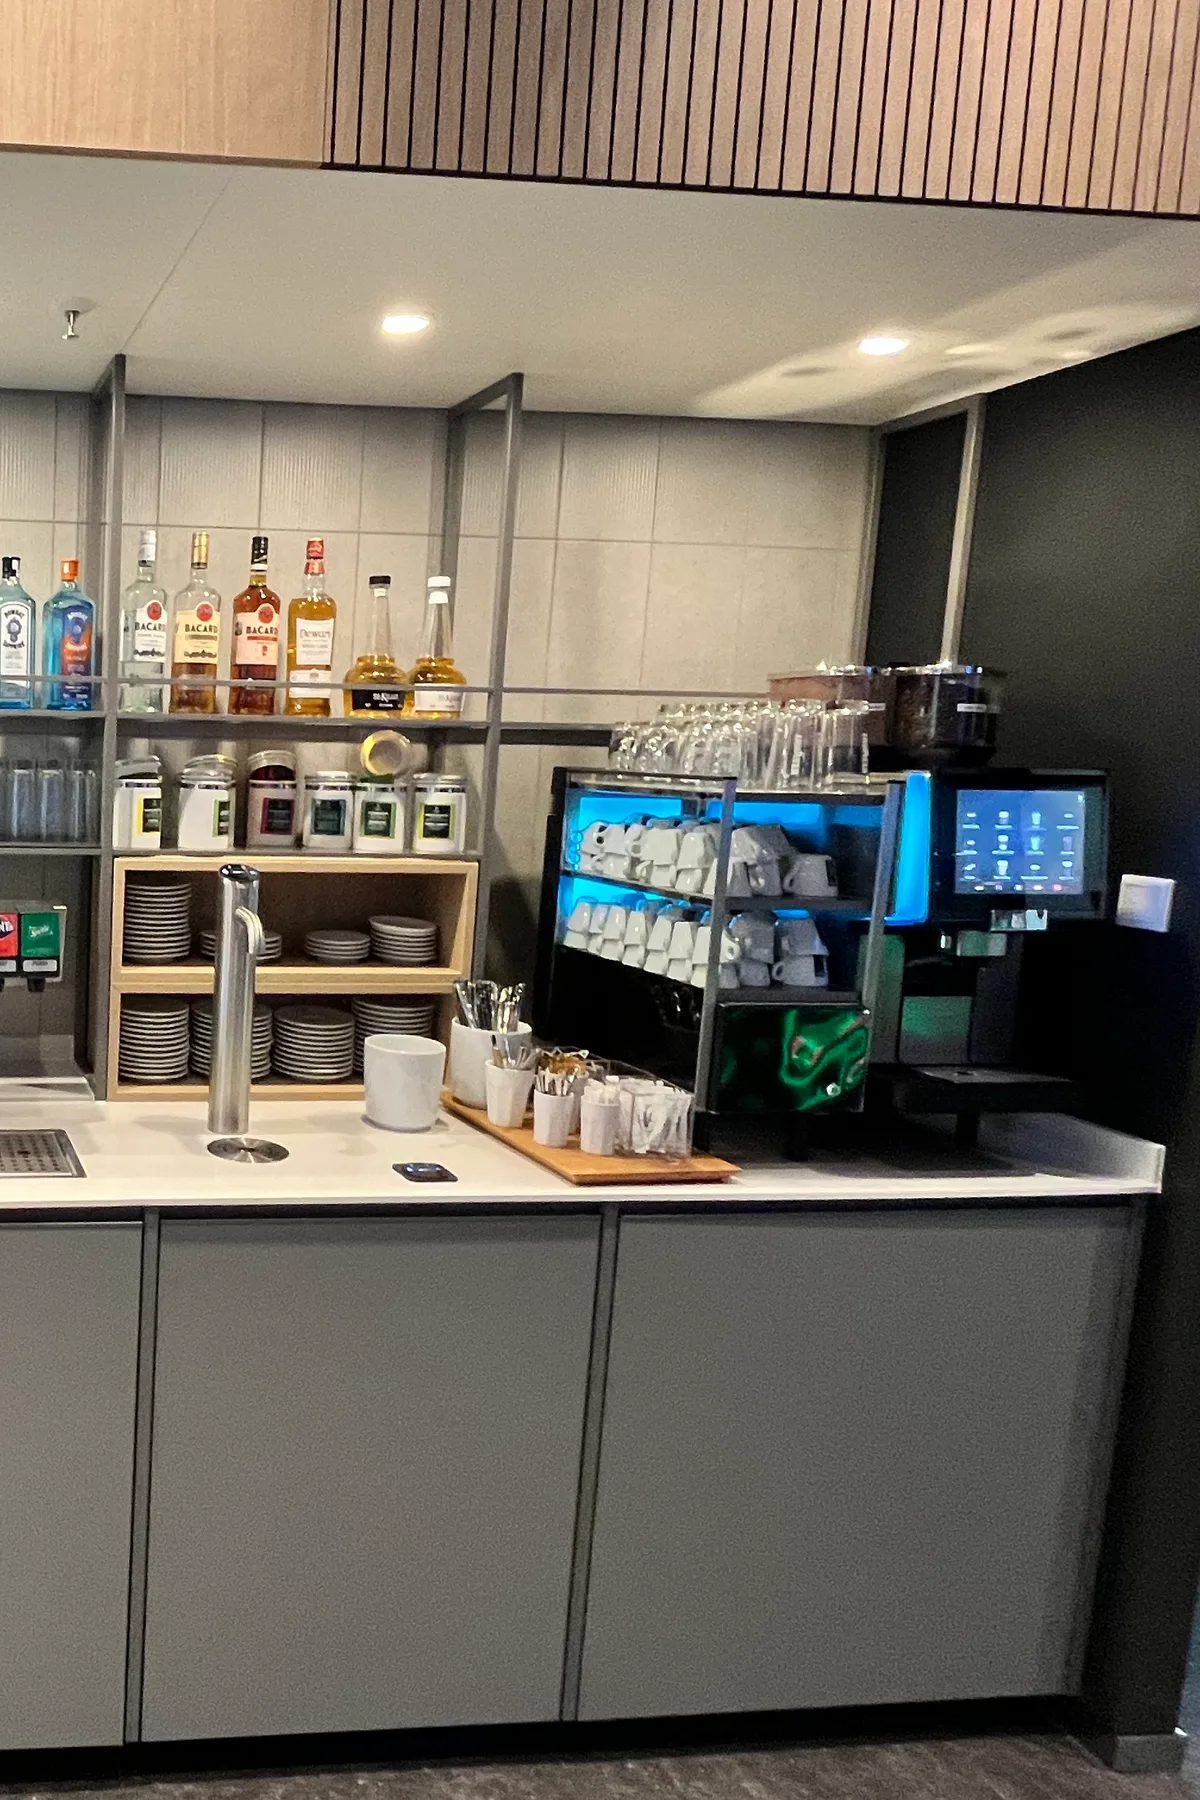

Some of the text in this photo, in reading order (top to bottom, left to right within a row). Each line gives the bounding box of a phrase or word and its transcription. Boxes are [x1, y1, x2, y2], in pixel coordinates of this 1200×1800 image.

[135, 621, 166, 632] BACARD
[185, 623, 218, 634] BACARD
[246, 625, 278, 635] BACARD
